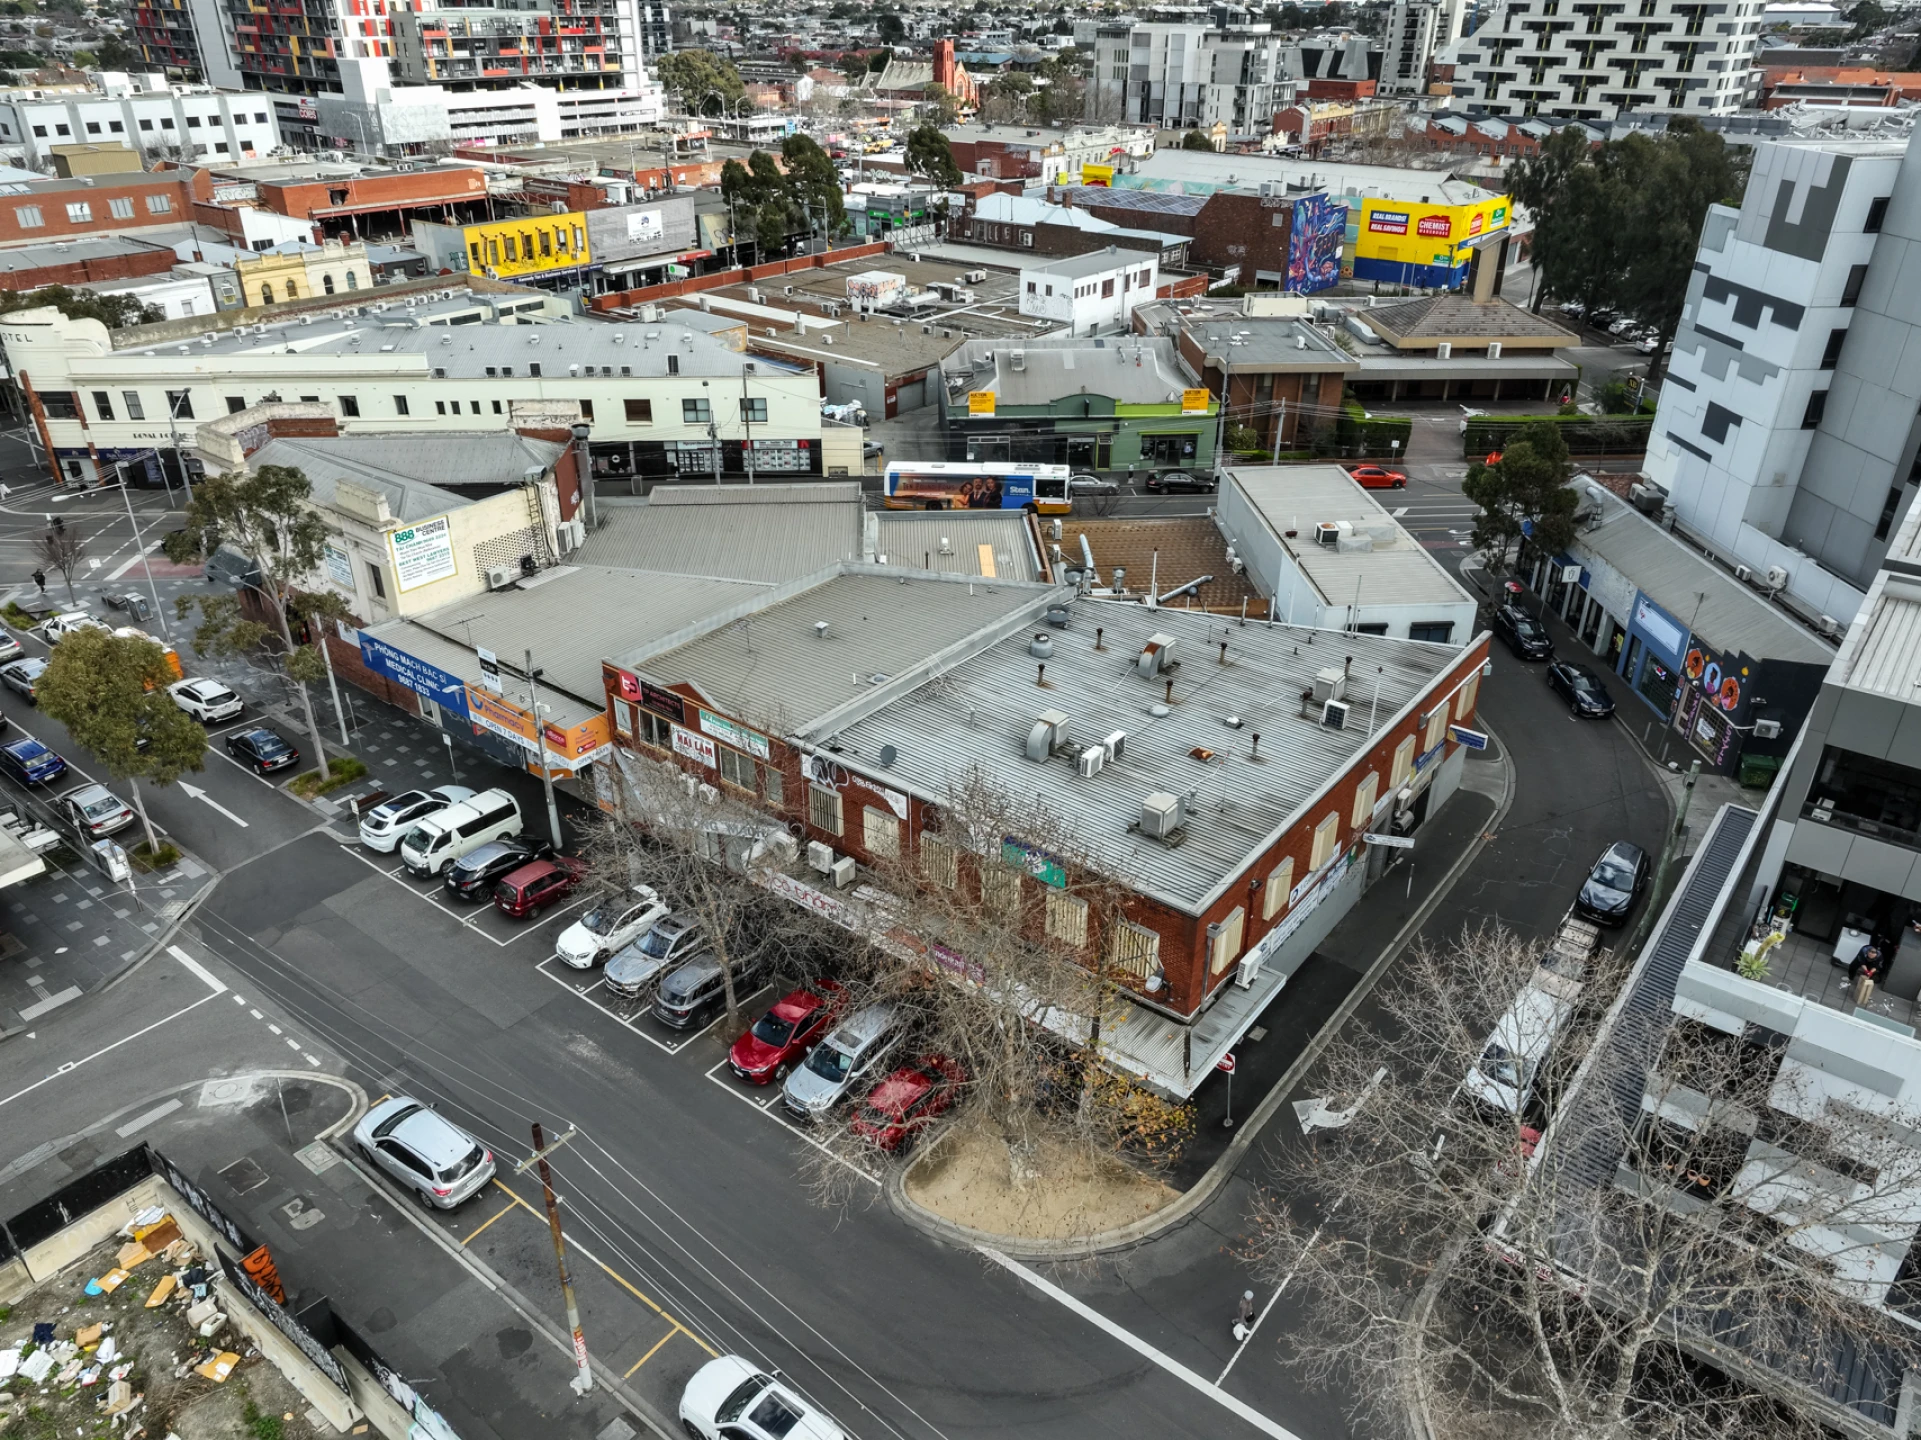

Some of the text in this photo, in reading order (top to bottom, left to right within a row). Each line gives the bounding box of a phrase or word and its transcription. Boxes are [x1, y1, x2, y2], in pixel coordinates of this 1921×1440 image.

[1418, 220, 1450, 231] CHEMIST
[1010, 486, 1031, 494] Stan.
[394, 520, 445, 543] 888 BUSINESS
[422, 524, 445, 536] CENTRE
[385, 658, 441, 692] MEDICAL CLINIC
[484, 704, 525, 733] Pharmacy
[485, 719, 503, 734] OPEN
[507, 731, 525, 744] DAYS
